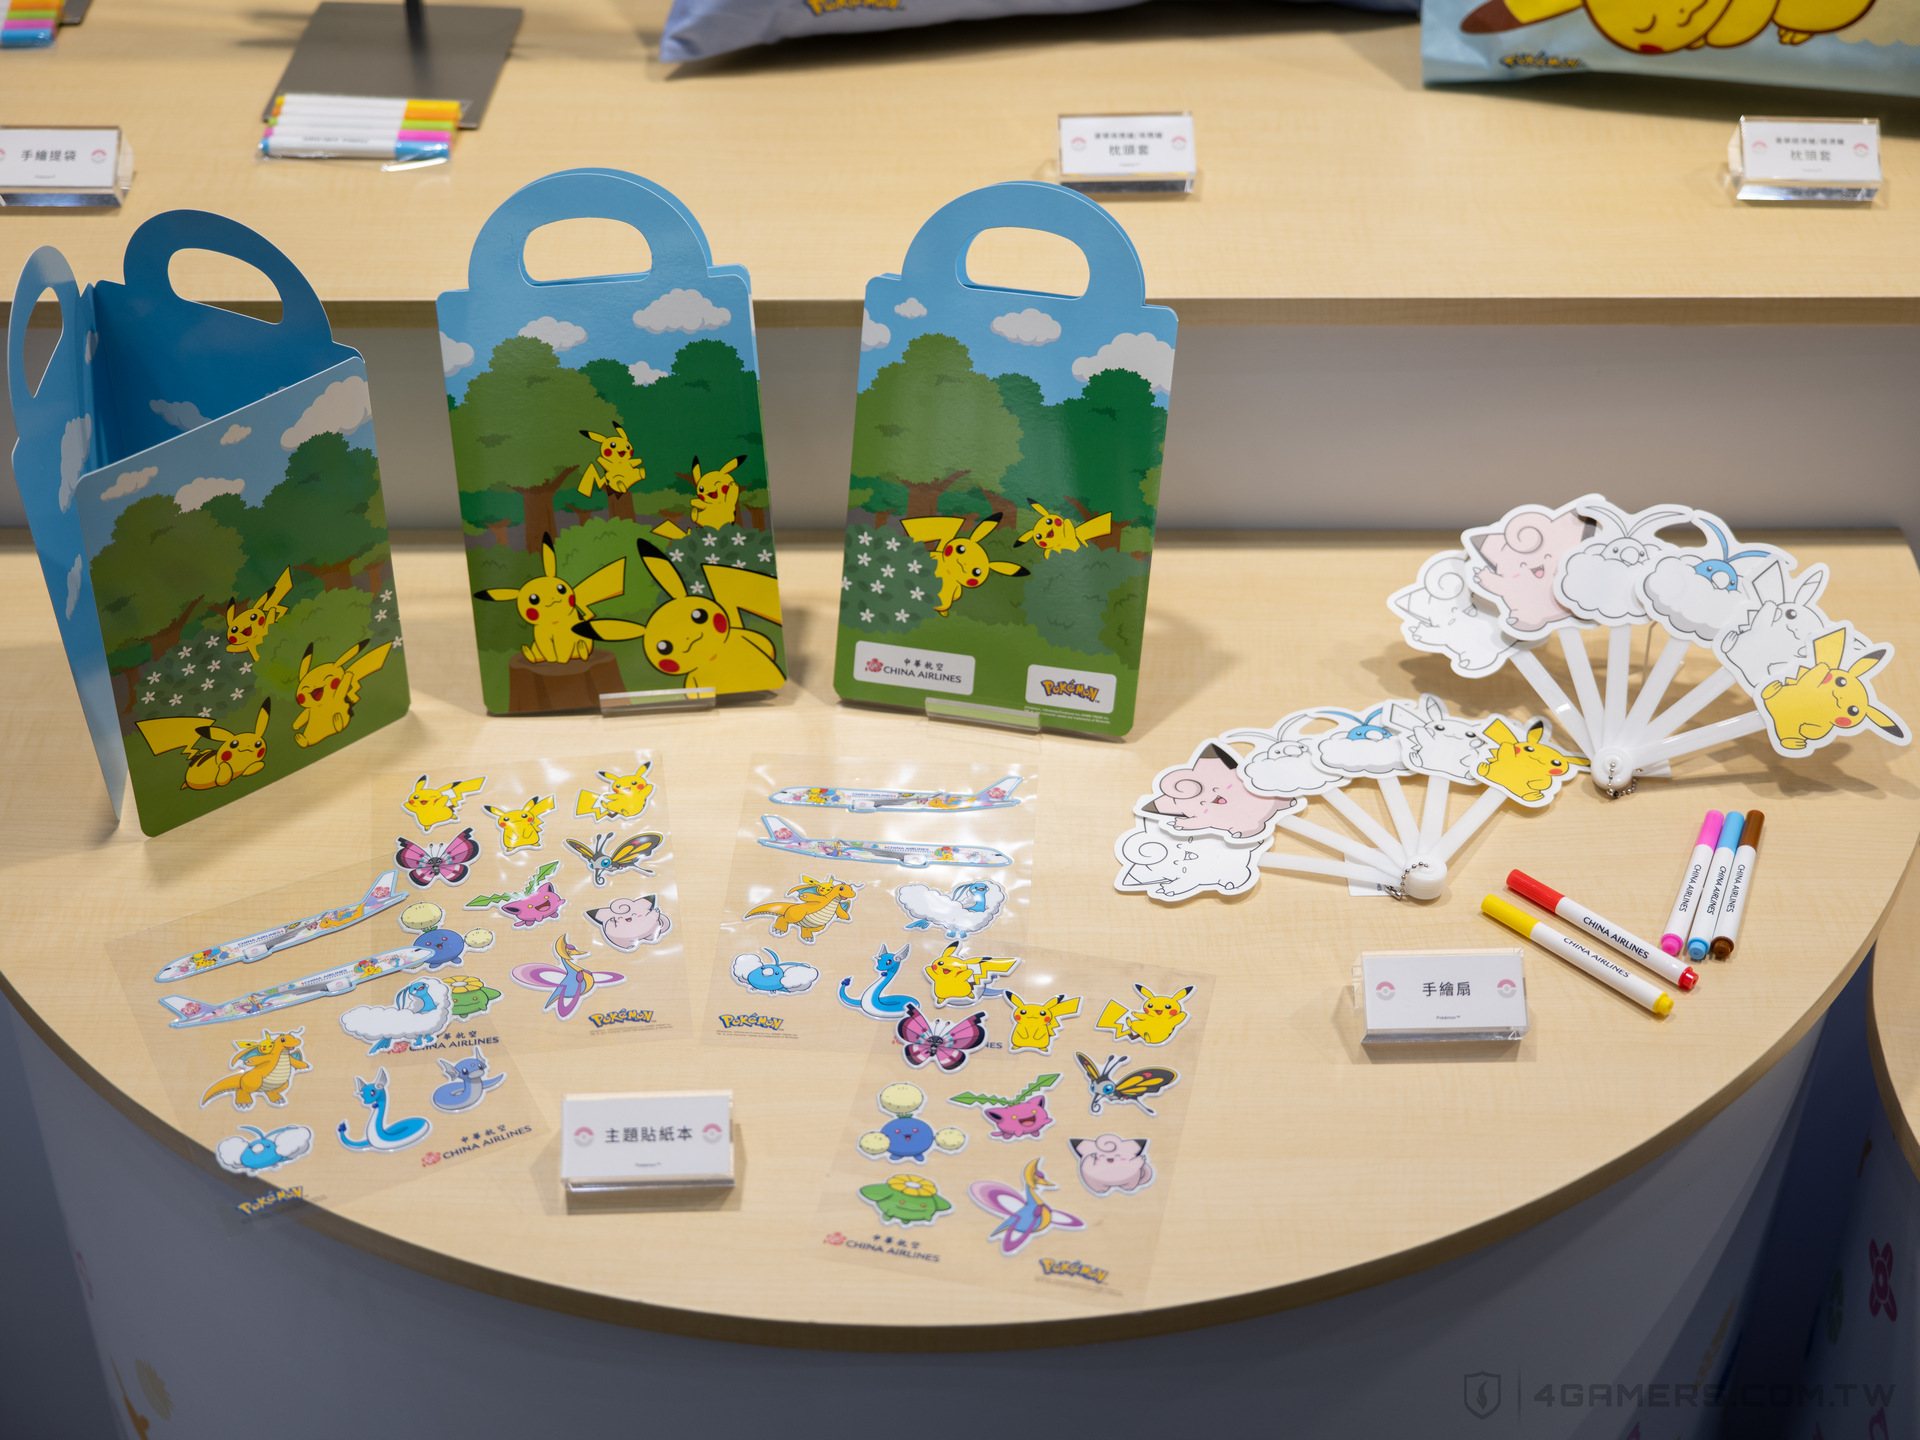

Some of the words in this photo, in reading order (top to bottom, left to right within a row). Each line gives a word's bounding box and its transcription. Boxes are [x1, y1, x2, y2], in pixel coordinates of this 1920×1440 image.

[21, 149, 76, 161] 手繪提袋
[883, 665, 915, 677] CHINA
[918, 671, 962, 683] AIRLINES
[904, 658, 943, 671] 中華航空
[1689, 864, 1702, 884] CHINA
[1715, 865, 1727, 886] CHINA
[1734, 864, 1746, 884] CHINA
[1679, 884, 1694, 912] AIRLINES
[1706, 886, 1721, 915] AIRLINES
[1726, 885, 1740, 913] AIRLINES
[1583, 916, 1610, 937] CHINA
[1610, 933, 1650, 960] AIRLINES
[1563, 937, 1591, 956] CHINA
[1591, 954, 1630, 978] AIRLINES
[1422, 981, 1471, 997] 手繪扇
[449, 1037, 499, 1048] AIRLINES
[443, 1143, 480, 1159] CHINA
[483, 1125, 532, 1147] AIRLINES
[605, 1125, 693, 1143] 主題貼紙本
[846, 1240, 884, 1253] CHINA
[886, 1247, 940, 1262] AIRLINES
